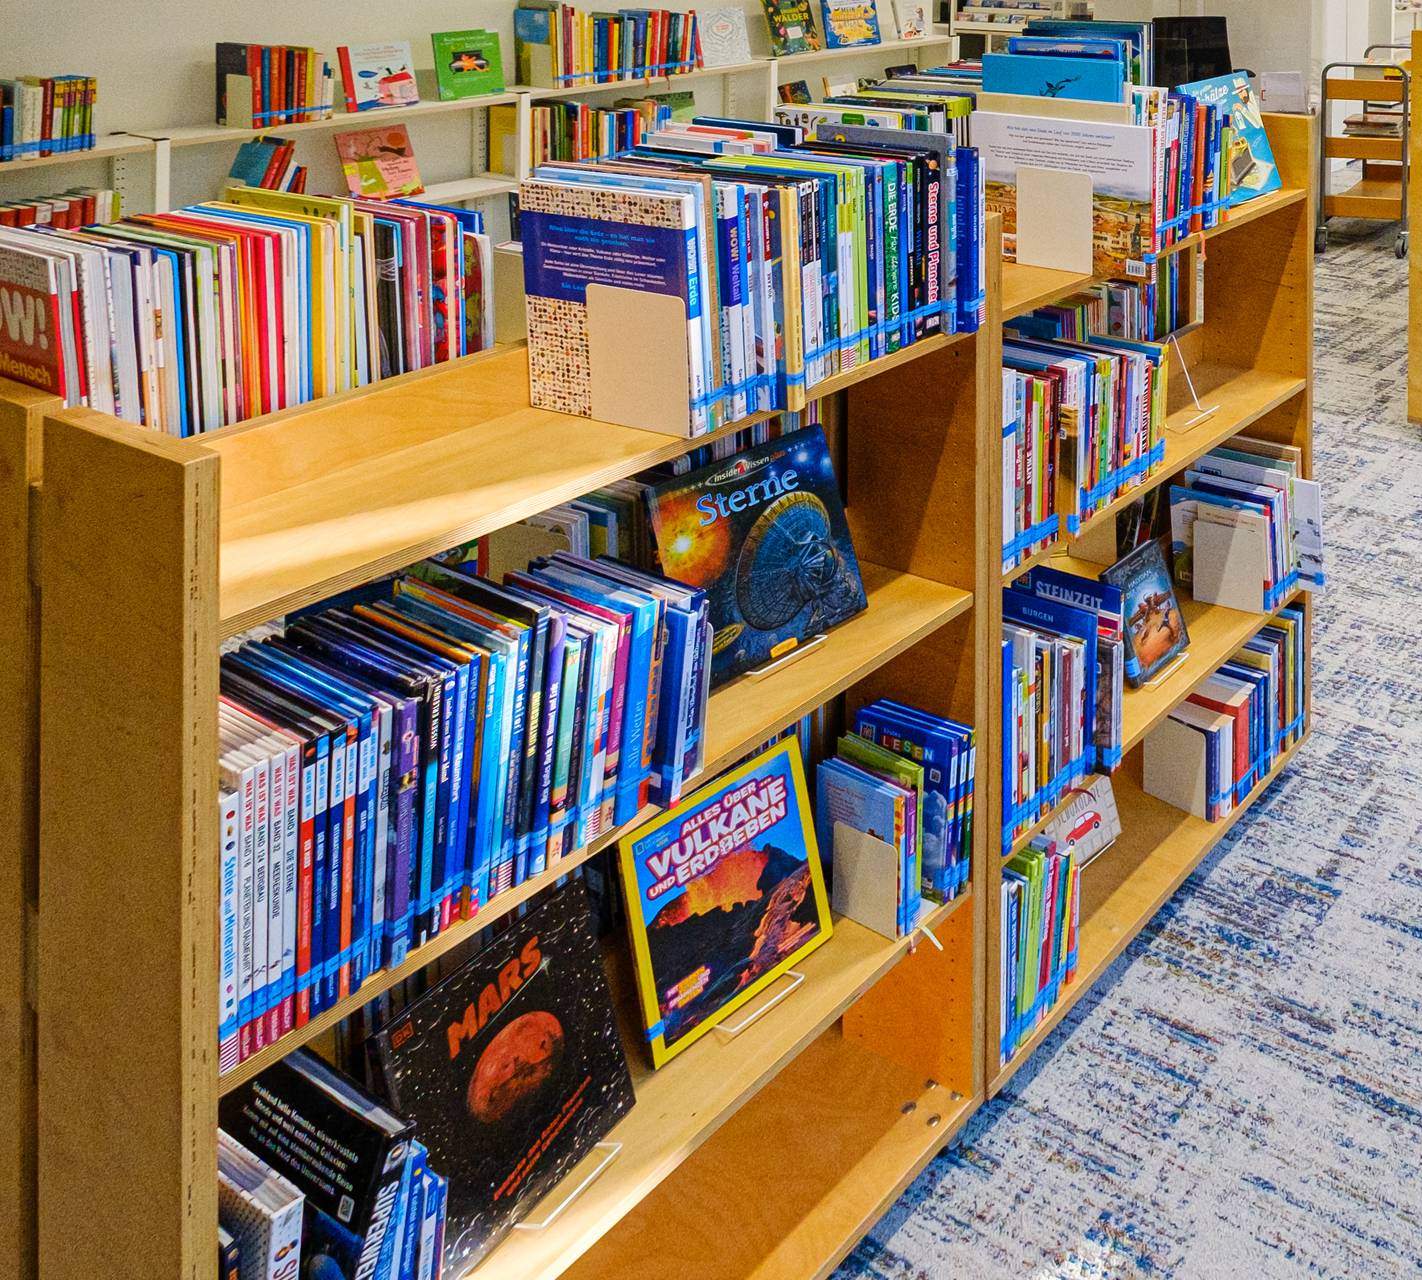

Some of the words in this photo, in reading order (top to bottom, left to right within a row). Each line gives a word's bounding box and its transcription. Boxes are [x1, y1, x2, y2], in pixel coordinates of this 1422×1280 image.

[888, 182, 896, 201] DIE
[928, 181, 939, 225] Sterne
[889, 203, 898, 232] ERDE
[730, 226, 739, 262] WOW!
[928, 225, 939, 250] und
[688, 276, 698, 306] Erde
[731, 264, 741, 301] Weltall
[696, 468, 799, 527] Sterne
[1035, 580, 1103, 611] STEINZEIT
[1022, 607, 1054, 624] BURGEN
[631, 700, 644, 744] Wetter
[882, 733, 934, 762] LESEN
[274, 767, 282, 784] WAS
[288, 755, 297, 772] WAS
[245, 780, 253, 797] WAS
[258, 771, 266, 788] WAS
[274, 786, 282, 798] IST
[288, 774, 296, 786] IST
[245, 799, 253, 811] IST
[258, 790, 266, 802] IST
[288, 788, 296, 805] WAS
[682, 803, 721, 835] ALLES
[723, 780, 756, 806] ÜBER
[273, 820, 281, 839] BAND
[287, 808, 295, 829] BAND
[648, 777, 787, 878] VULKANE
[244, 834, 252, 857] BAND
[257, 824, 266, 846] BAND
[649, 876, 676, 900] UND
[675, 800, 786, 885] ERDBEBEN
[224, 856, 235, 896] Steine
[256, 866, 265, 903] BERGBAU
[272, 861, 281, 919] MEERESKUNDE
[286, 864, 295, 893] STERNE
[224, 913, 236, 979] Mineralien
[448, 936, 541, 1061] MARS
